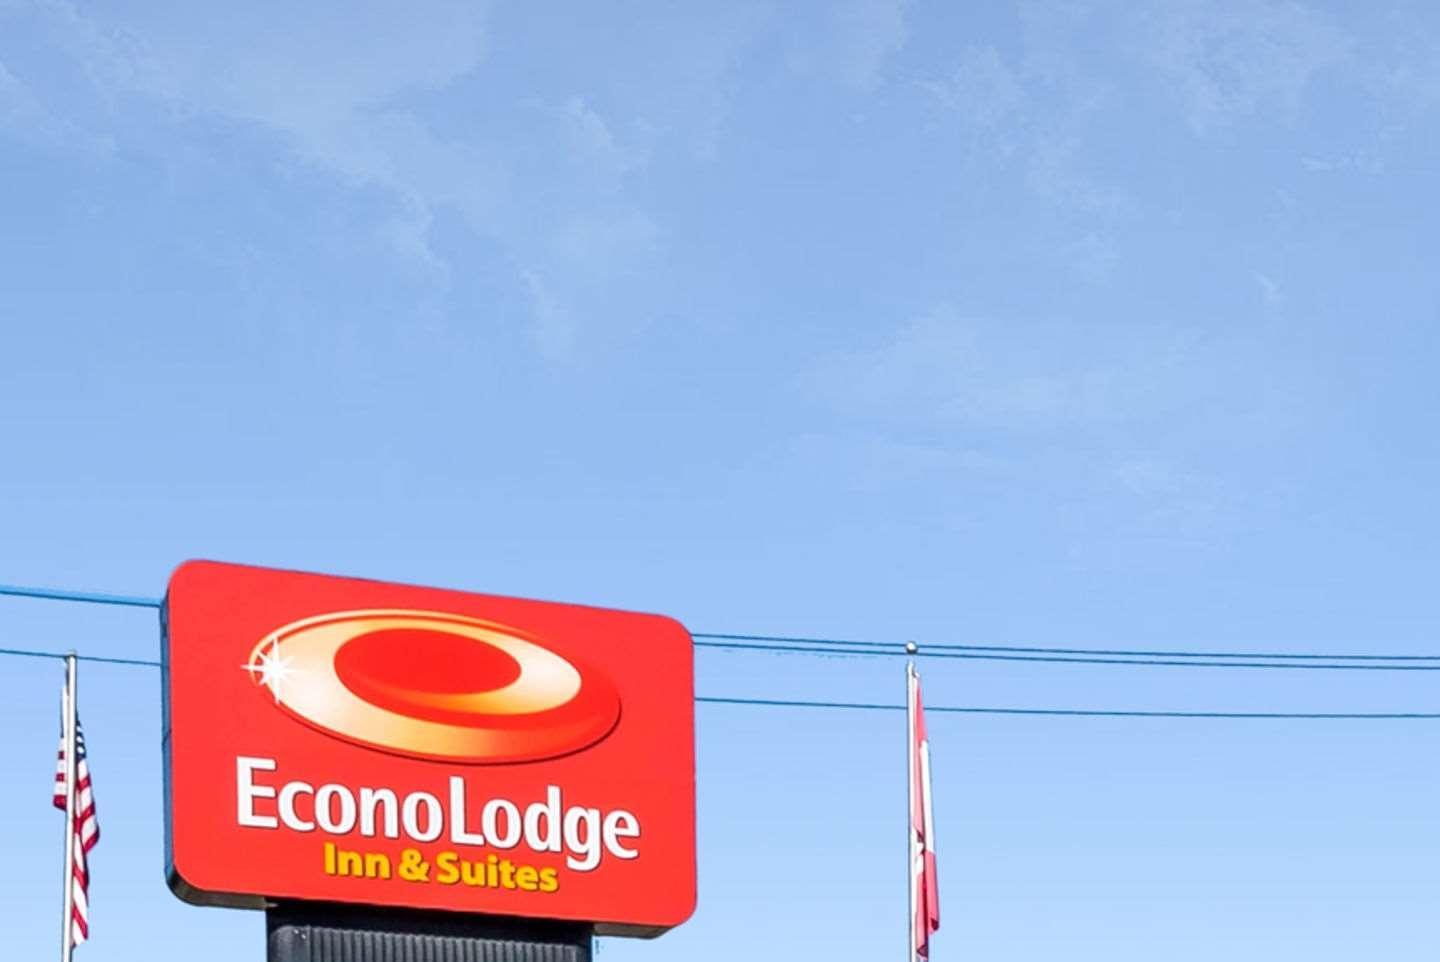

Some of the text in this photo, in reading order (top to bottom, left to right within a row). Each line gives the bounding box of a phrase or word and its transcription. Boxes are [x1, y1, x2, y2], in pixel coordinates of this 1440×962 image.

[236, 755, 641, 872] EconoLodge
[324, 842, 560, 893] Inn & Suites
